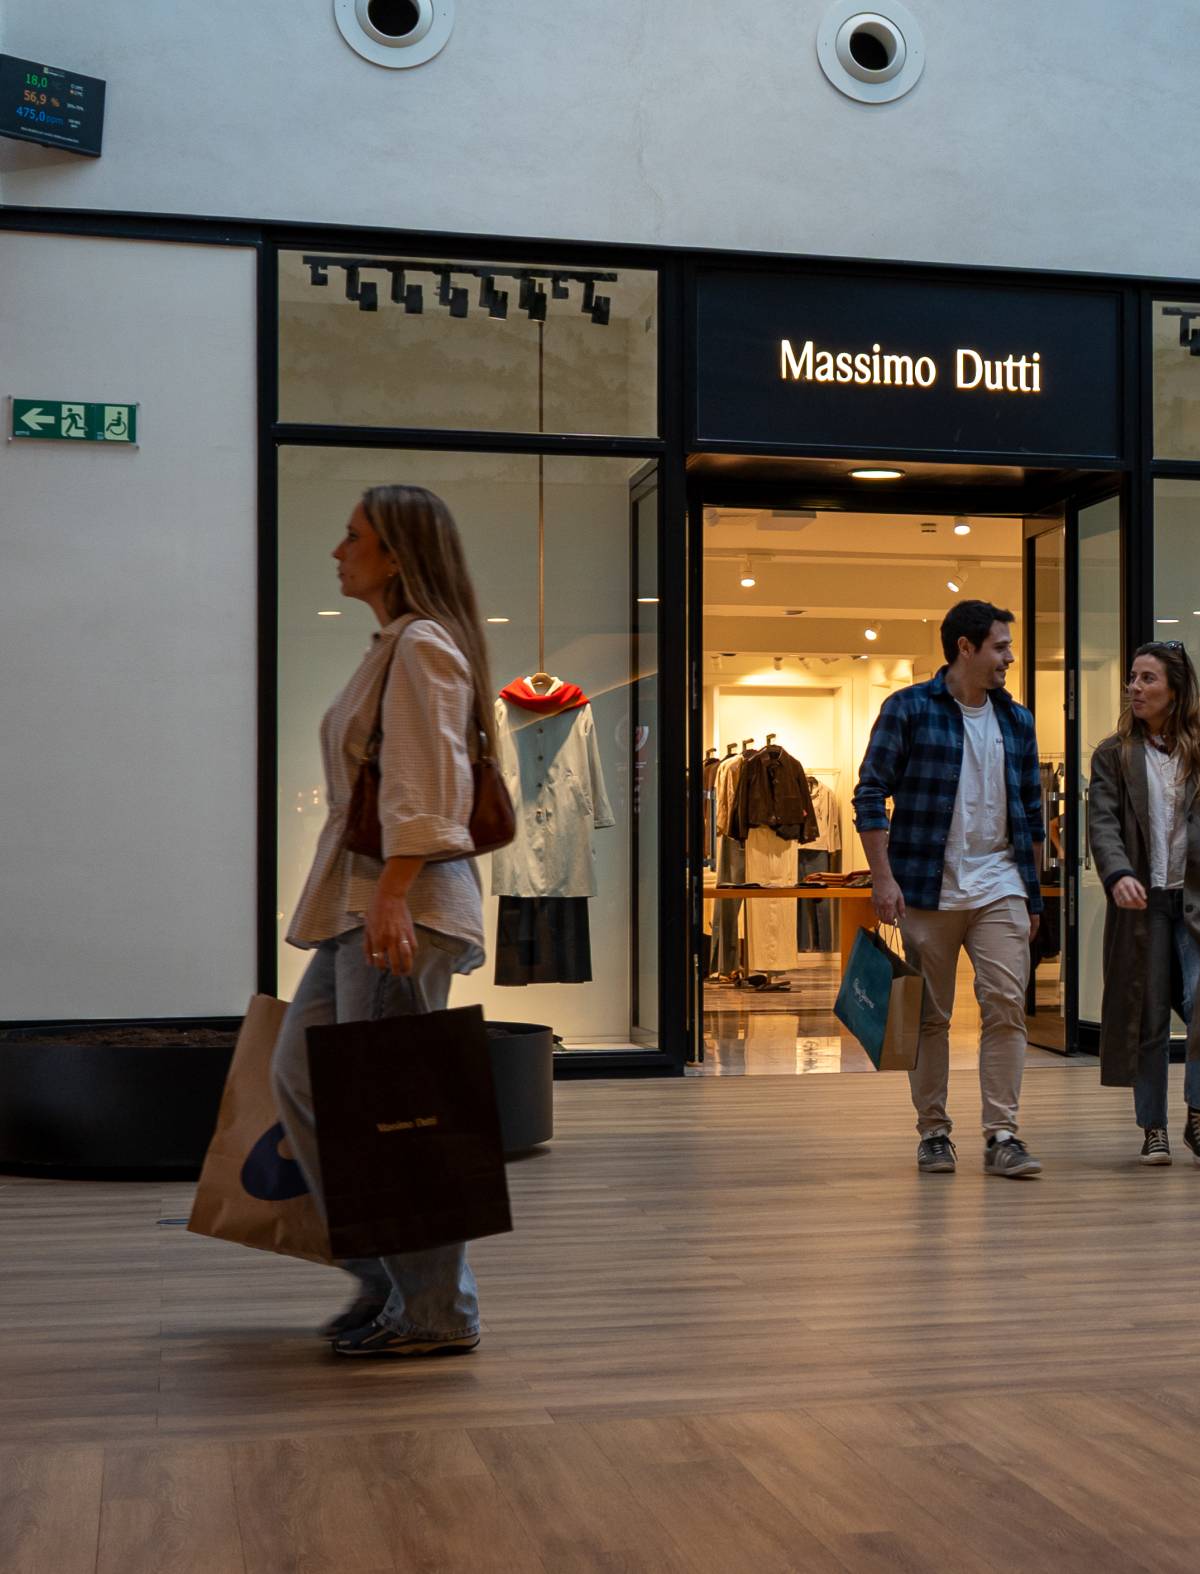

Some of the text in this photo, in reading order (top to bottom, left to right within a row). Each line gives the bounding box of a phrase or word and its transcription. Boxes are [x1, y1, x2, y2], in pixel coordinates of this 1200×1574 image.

[24, 90, 47, 105] 56,9
[16, 106, 46, 122] 475,0
[781, 339, 1041, 392] Massimo Dutti
